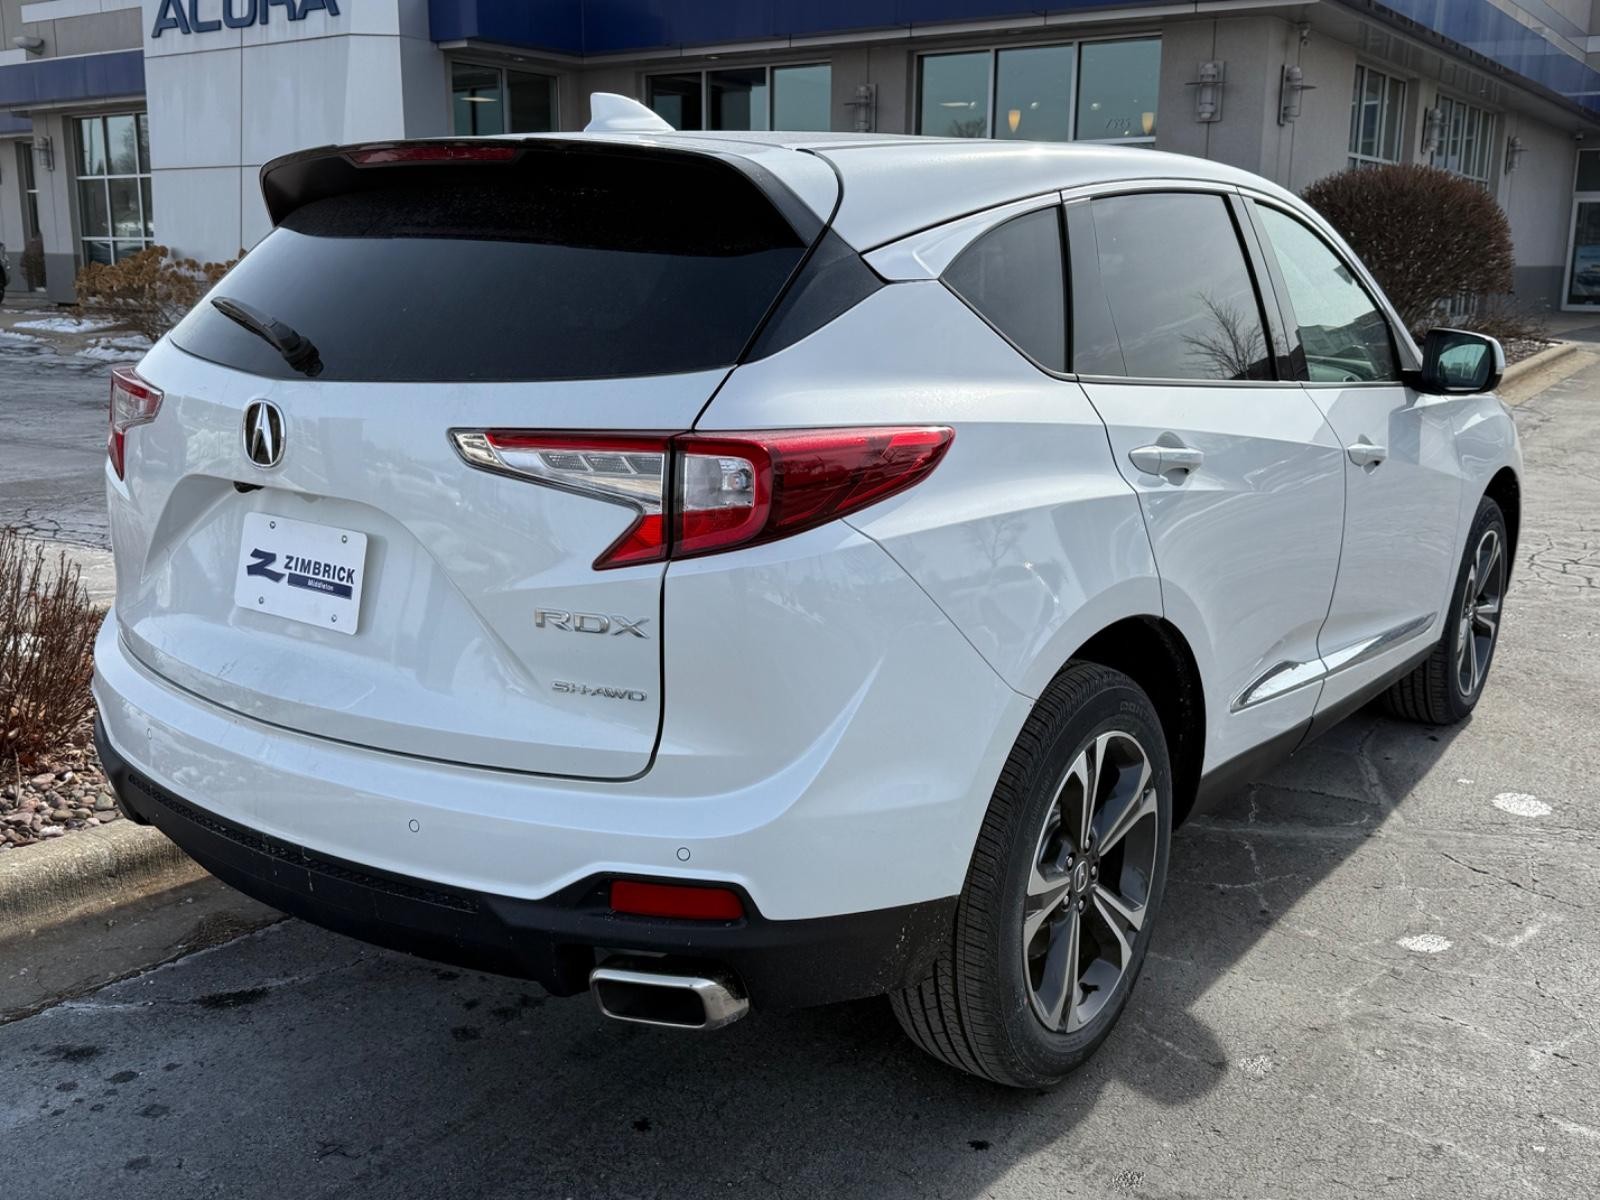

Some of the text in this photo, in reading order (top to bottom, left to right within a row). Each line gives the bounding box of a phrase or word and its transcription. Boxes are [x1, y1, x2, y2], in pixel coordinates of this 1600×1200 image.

[284, 555, 355, 584] ZIMBRICK
[307, 579, 334, 591] Middleton
[535, 607, 650, 639] RDX
[551, 681, 648, 702] SH-AWD
